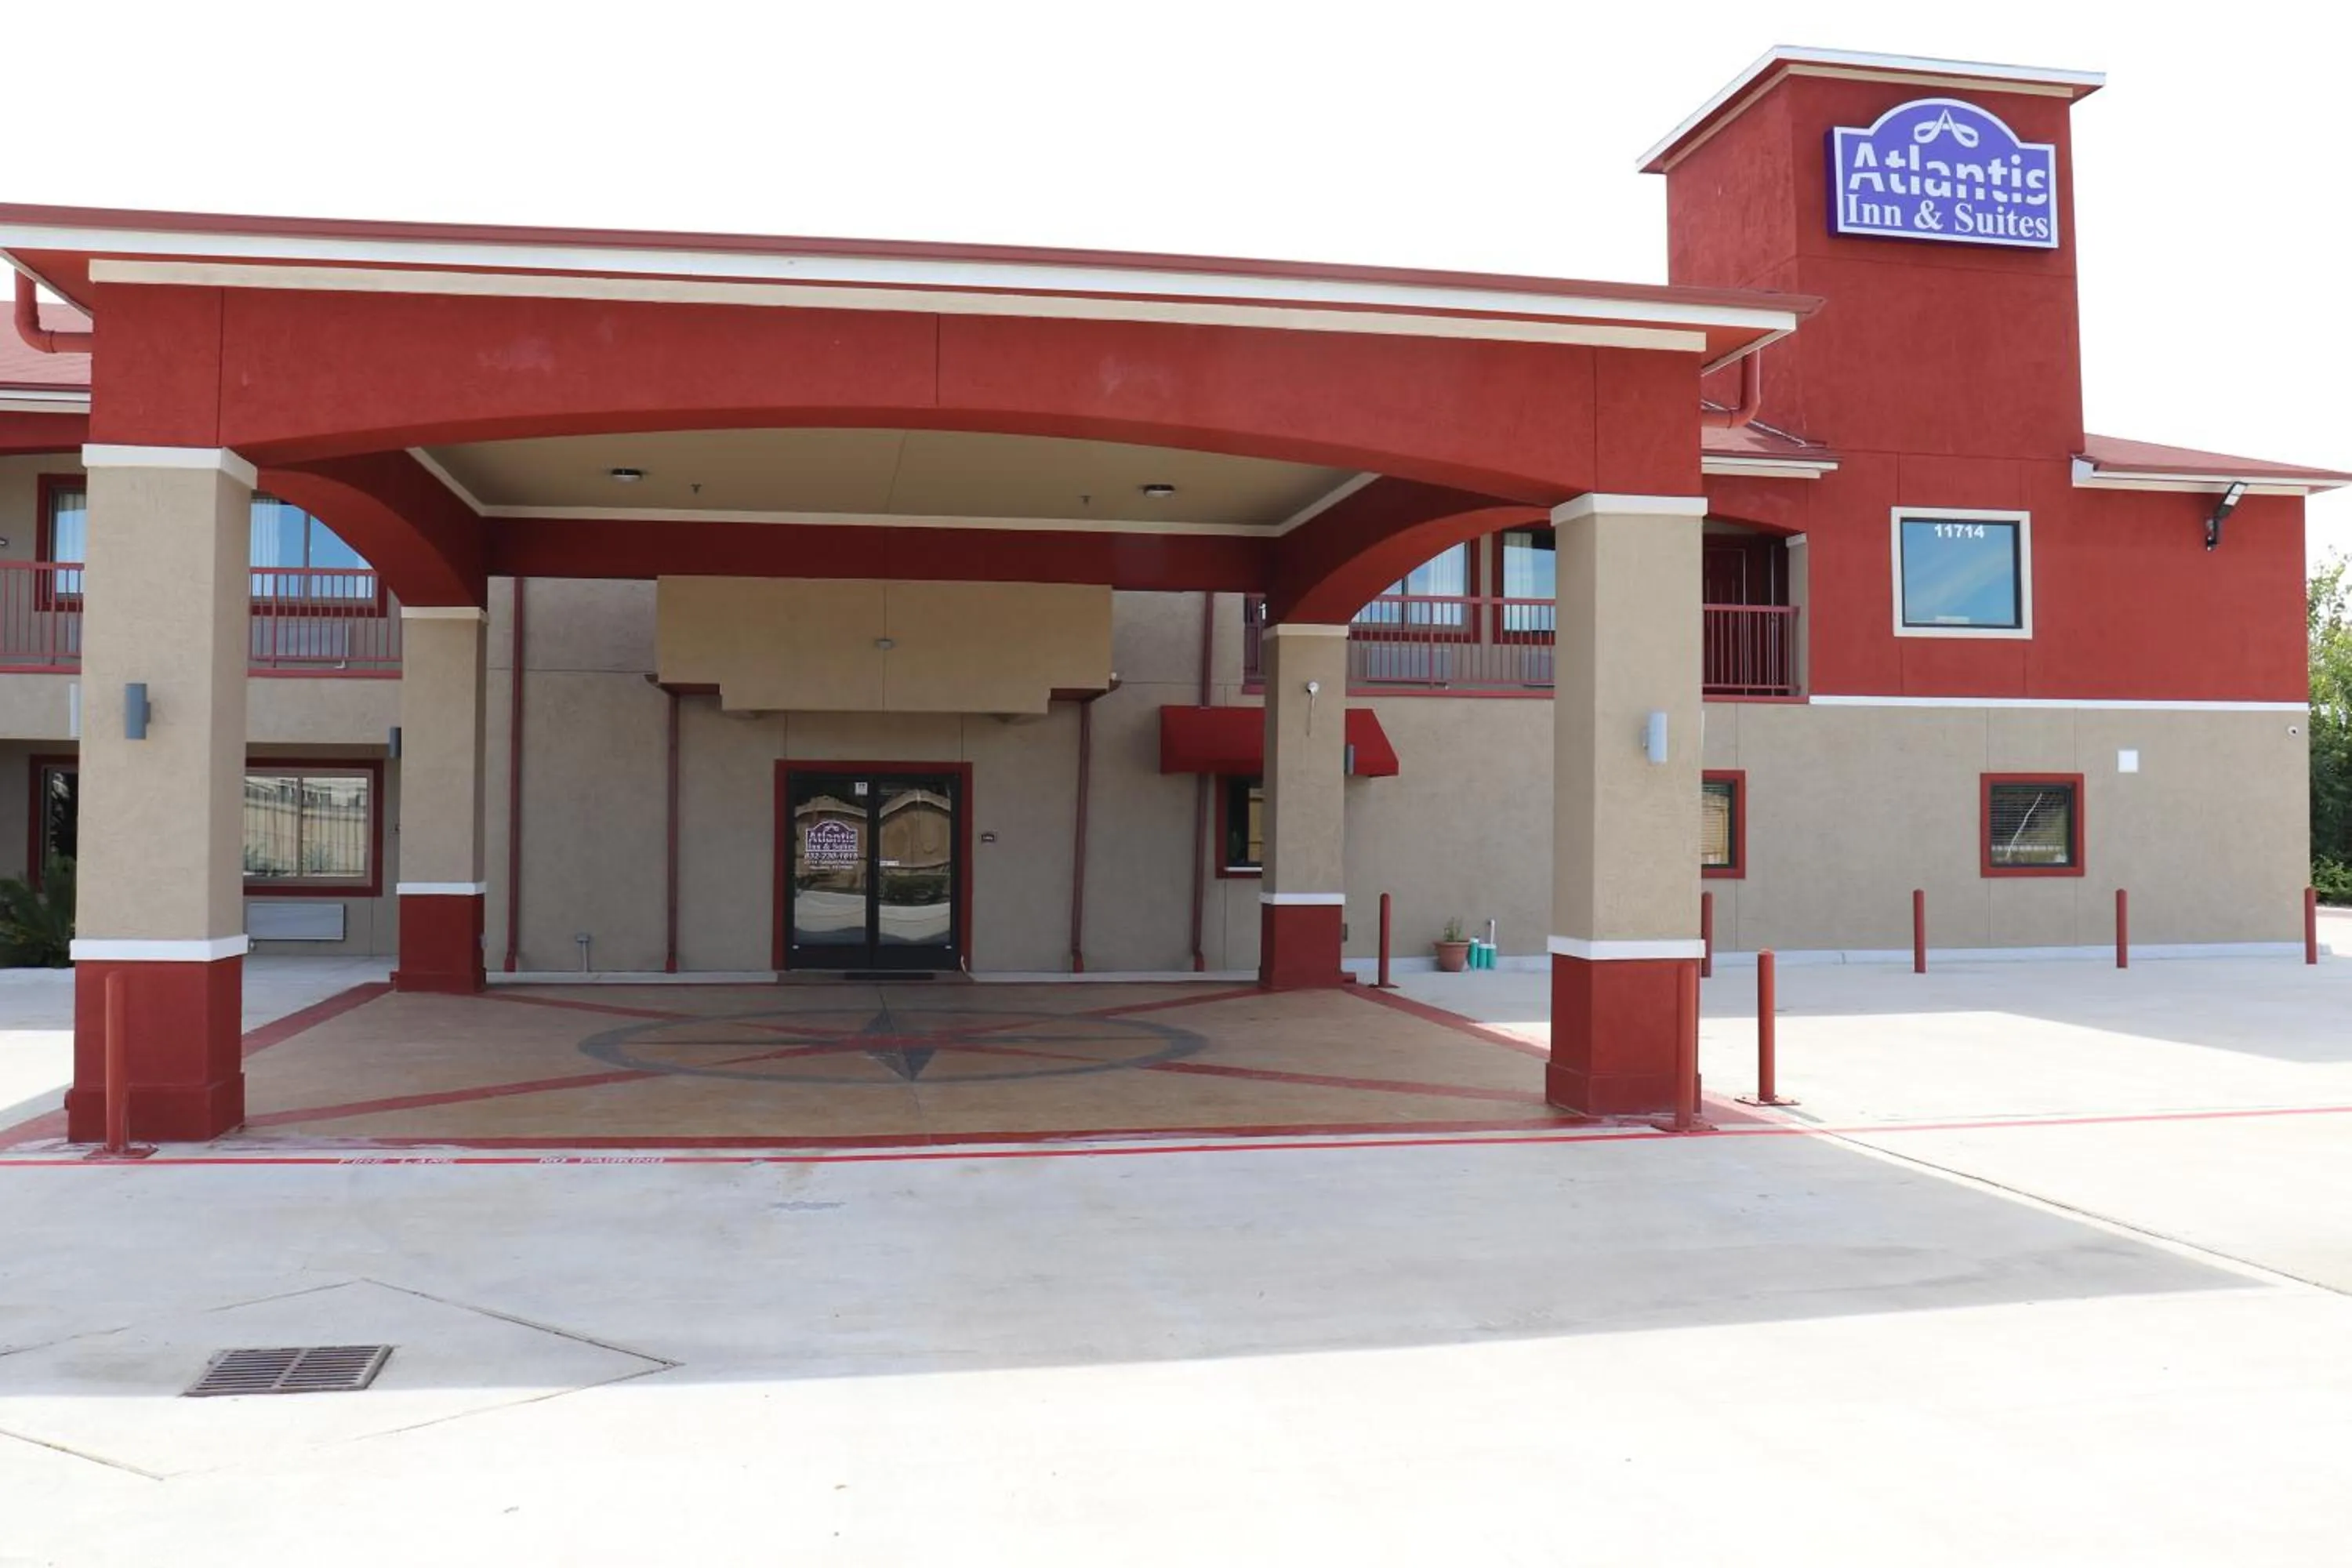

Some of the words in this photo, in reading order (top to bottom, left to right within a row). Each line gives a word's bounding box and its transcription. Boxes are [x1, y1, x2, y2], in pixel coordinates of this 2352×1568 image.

[1848, 141, 2049, 205] Atlantis
[1845, 194, 1903, 227] Inn
[1914, 199, 1944, 230] &
[1955, 202, 2049, 239] Suites
[1934, 523, 1985, 539] 11714
[808, 831, 855, 844] Atlantis
